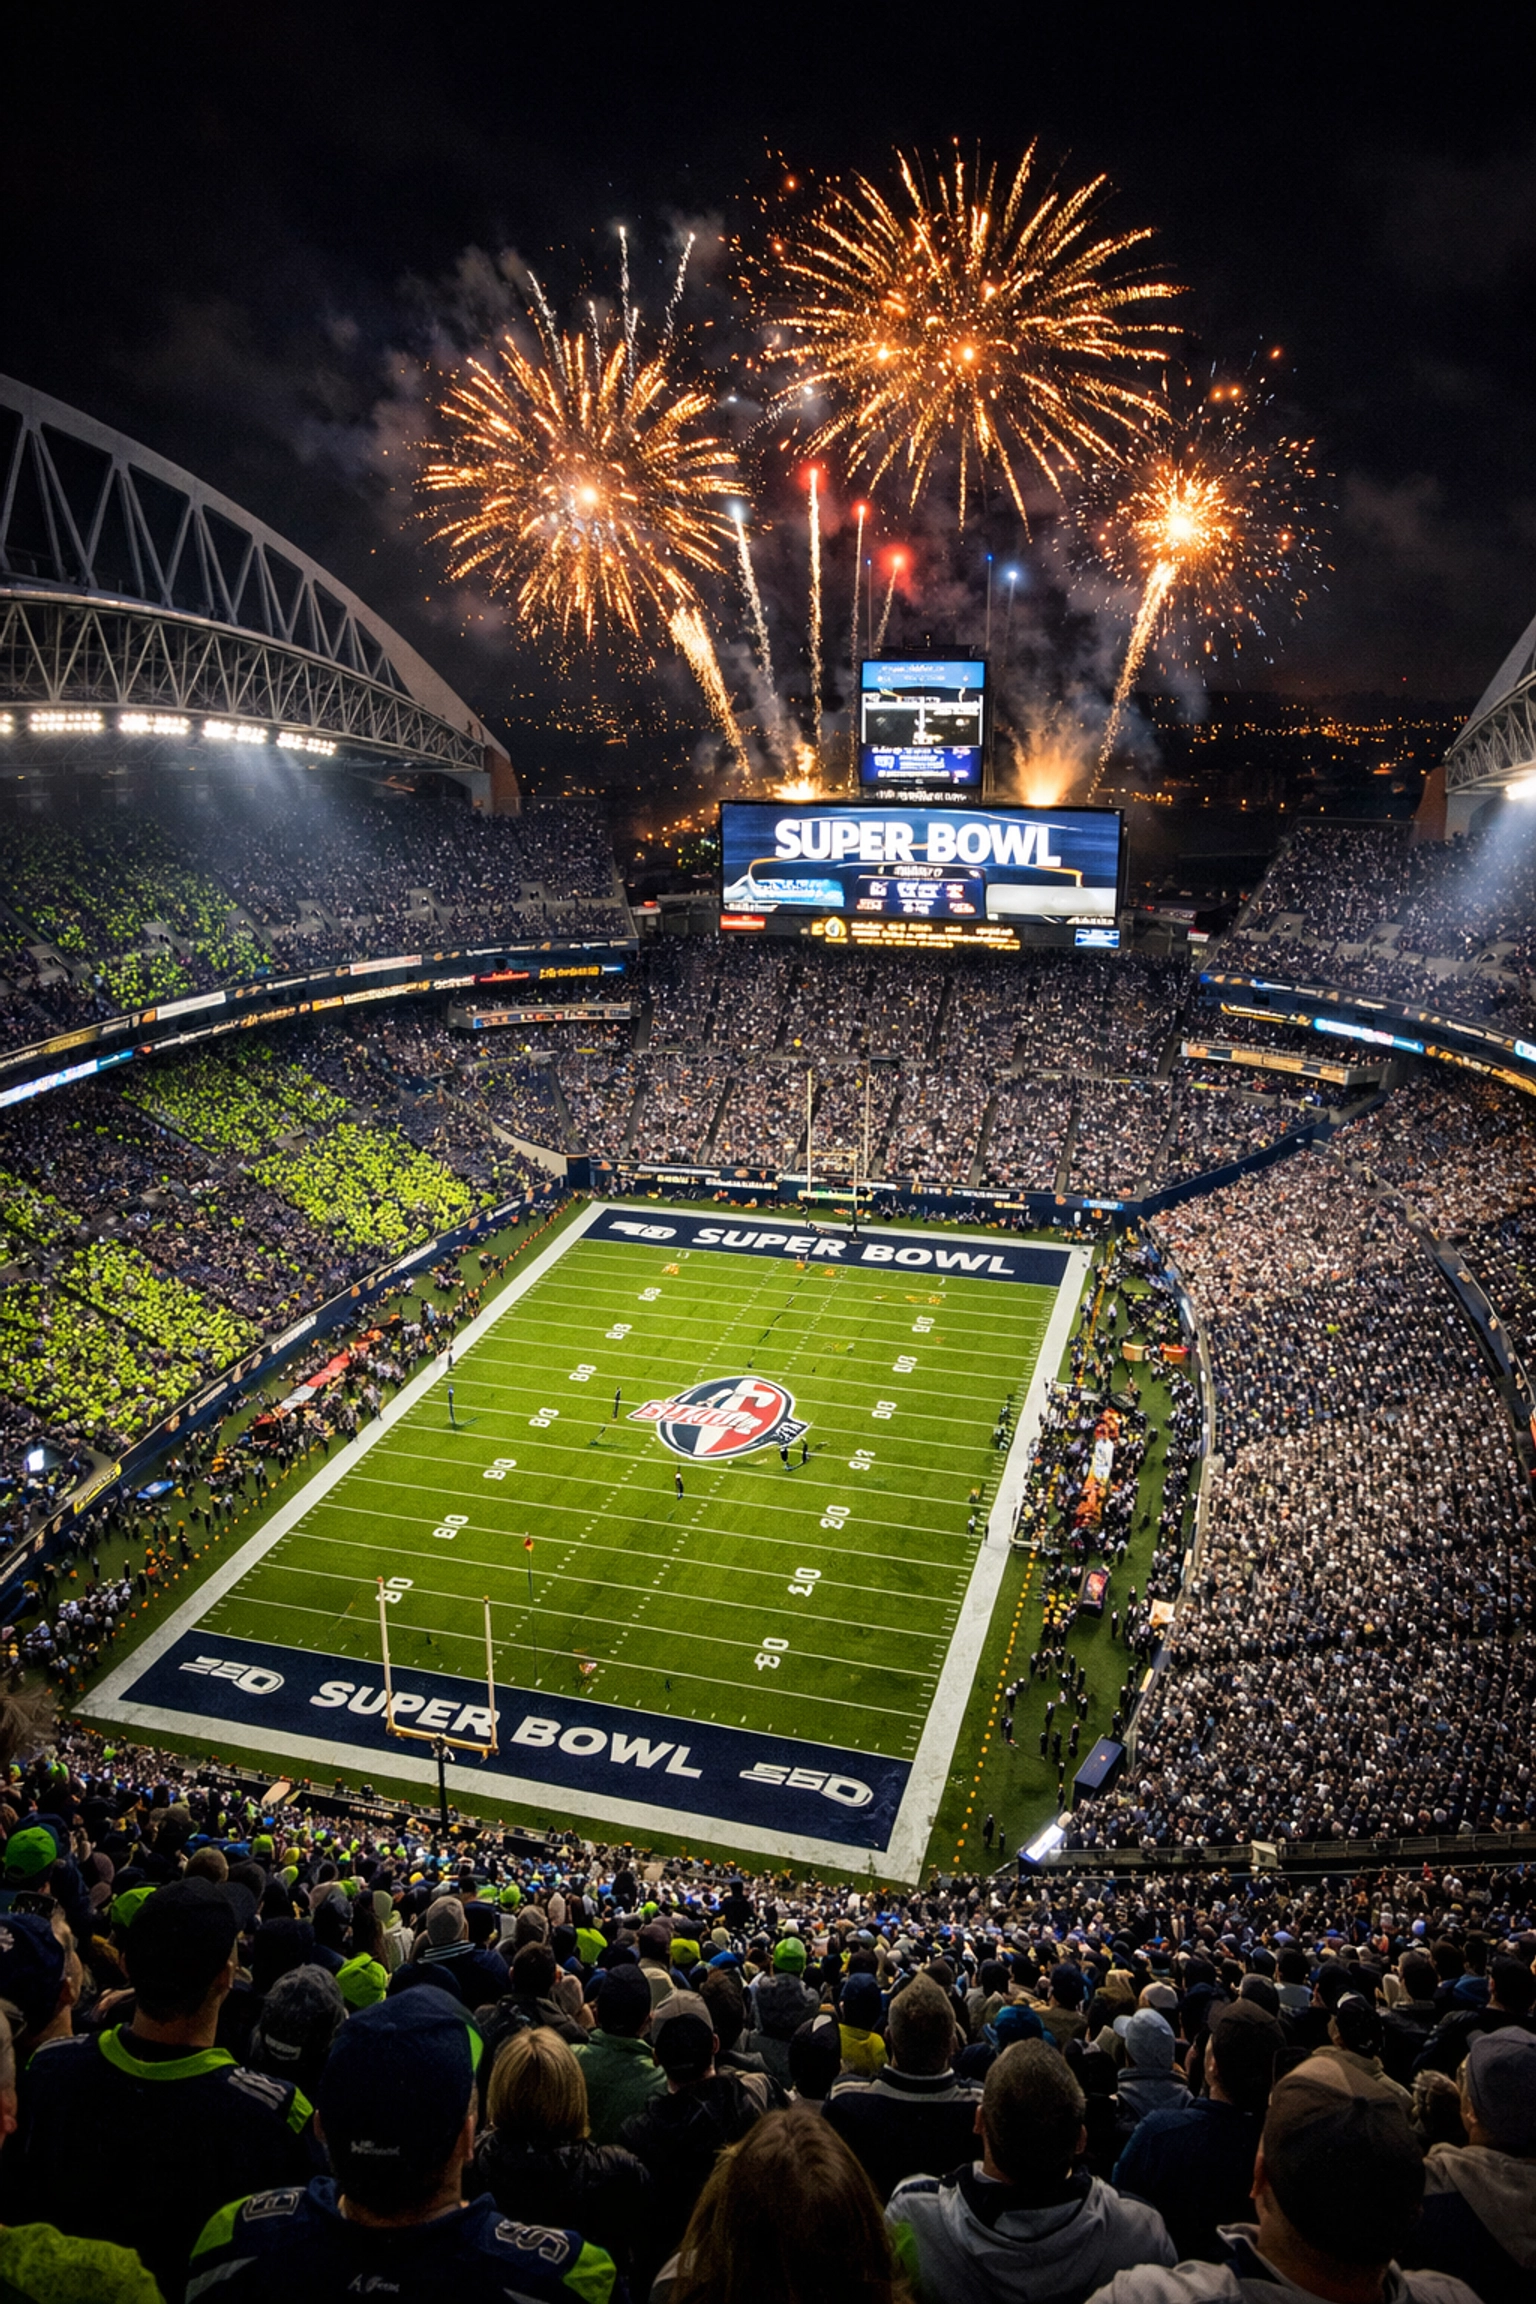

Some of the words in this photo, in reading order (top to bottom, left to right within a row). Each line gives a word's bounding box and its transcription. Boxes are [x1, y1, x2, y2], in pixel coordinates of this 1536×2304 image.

[774, 818, 914, 863] SUPER
[926, 823, 1062, 868] BOWL
[693, 1228, 855, 1260] SUPER
[860, 1243, 1016, 1276] BOWL
[309, 1680, 500, 1738] SUPER
[511, 1713, 704, 1779] BOWL
